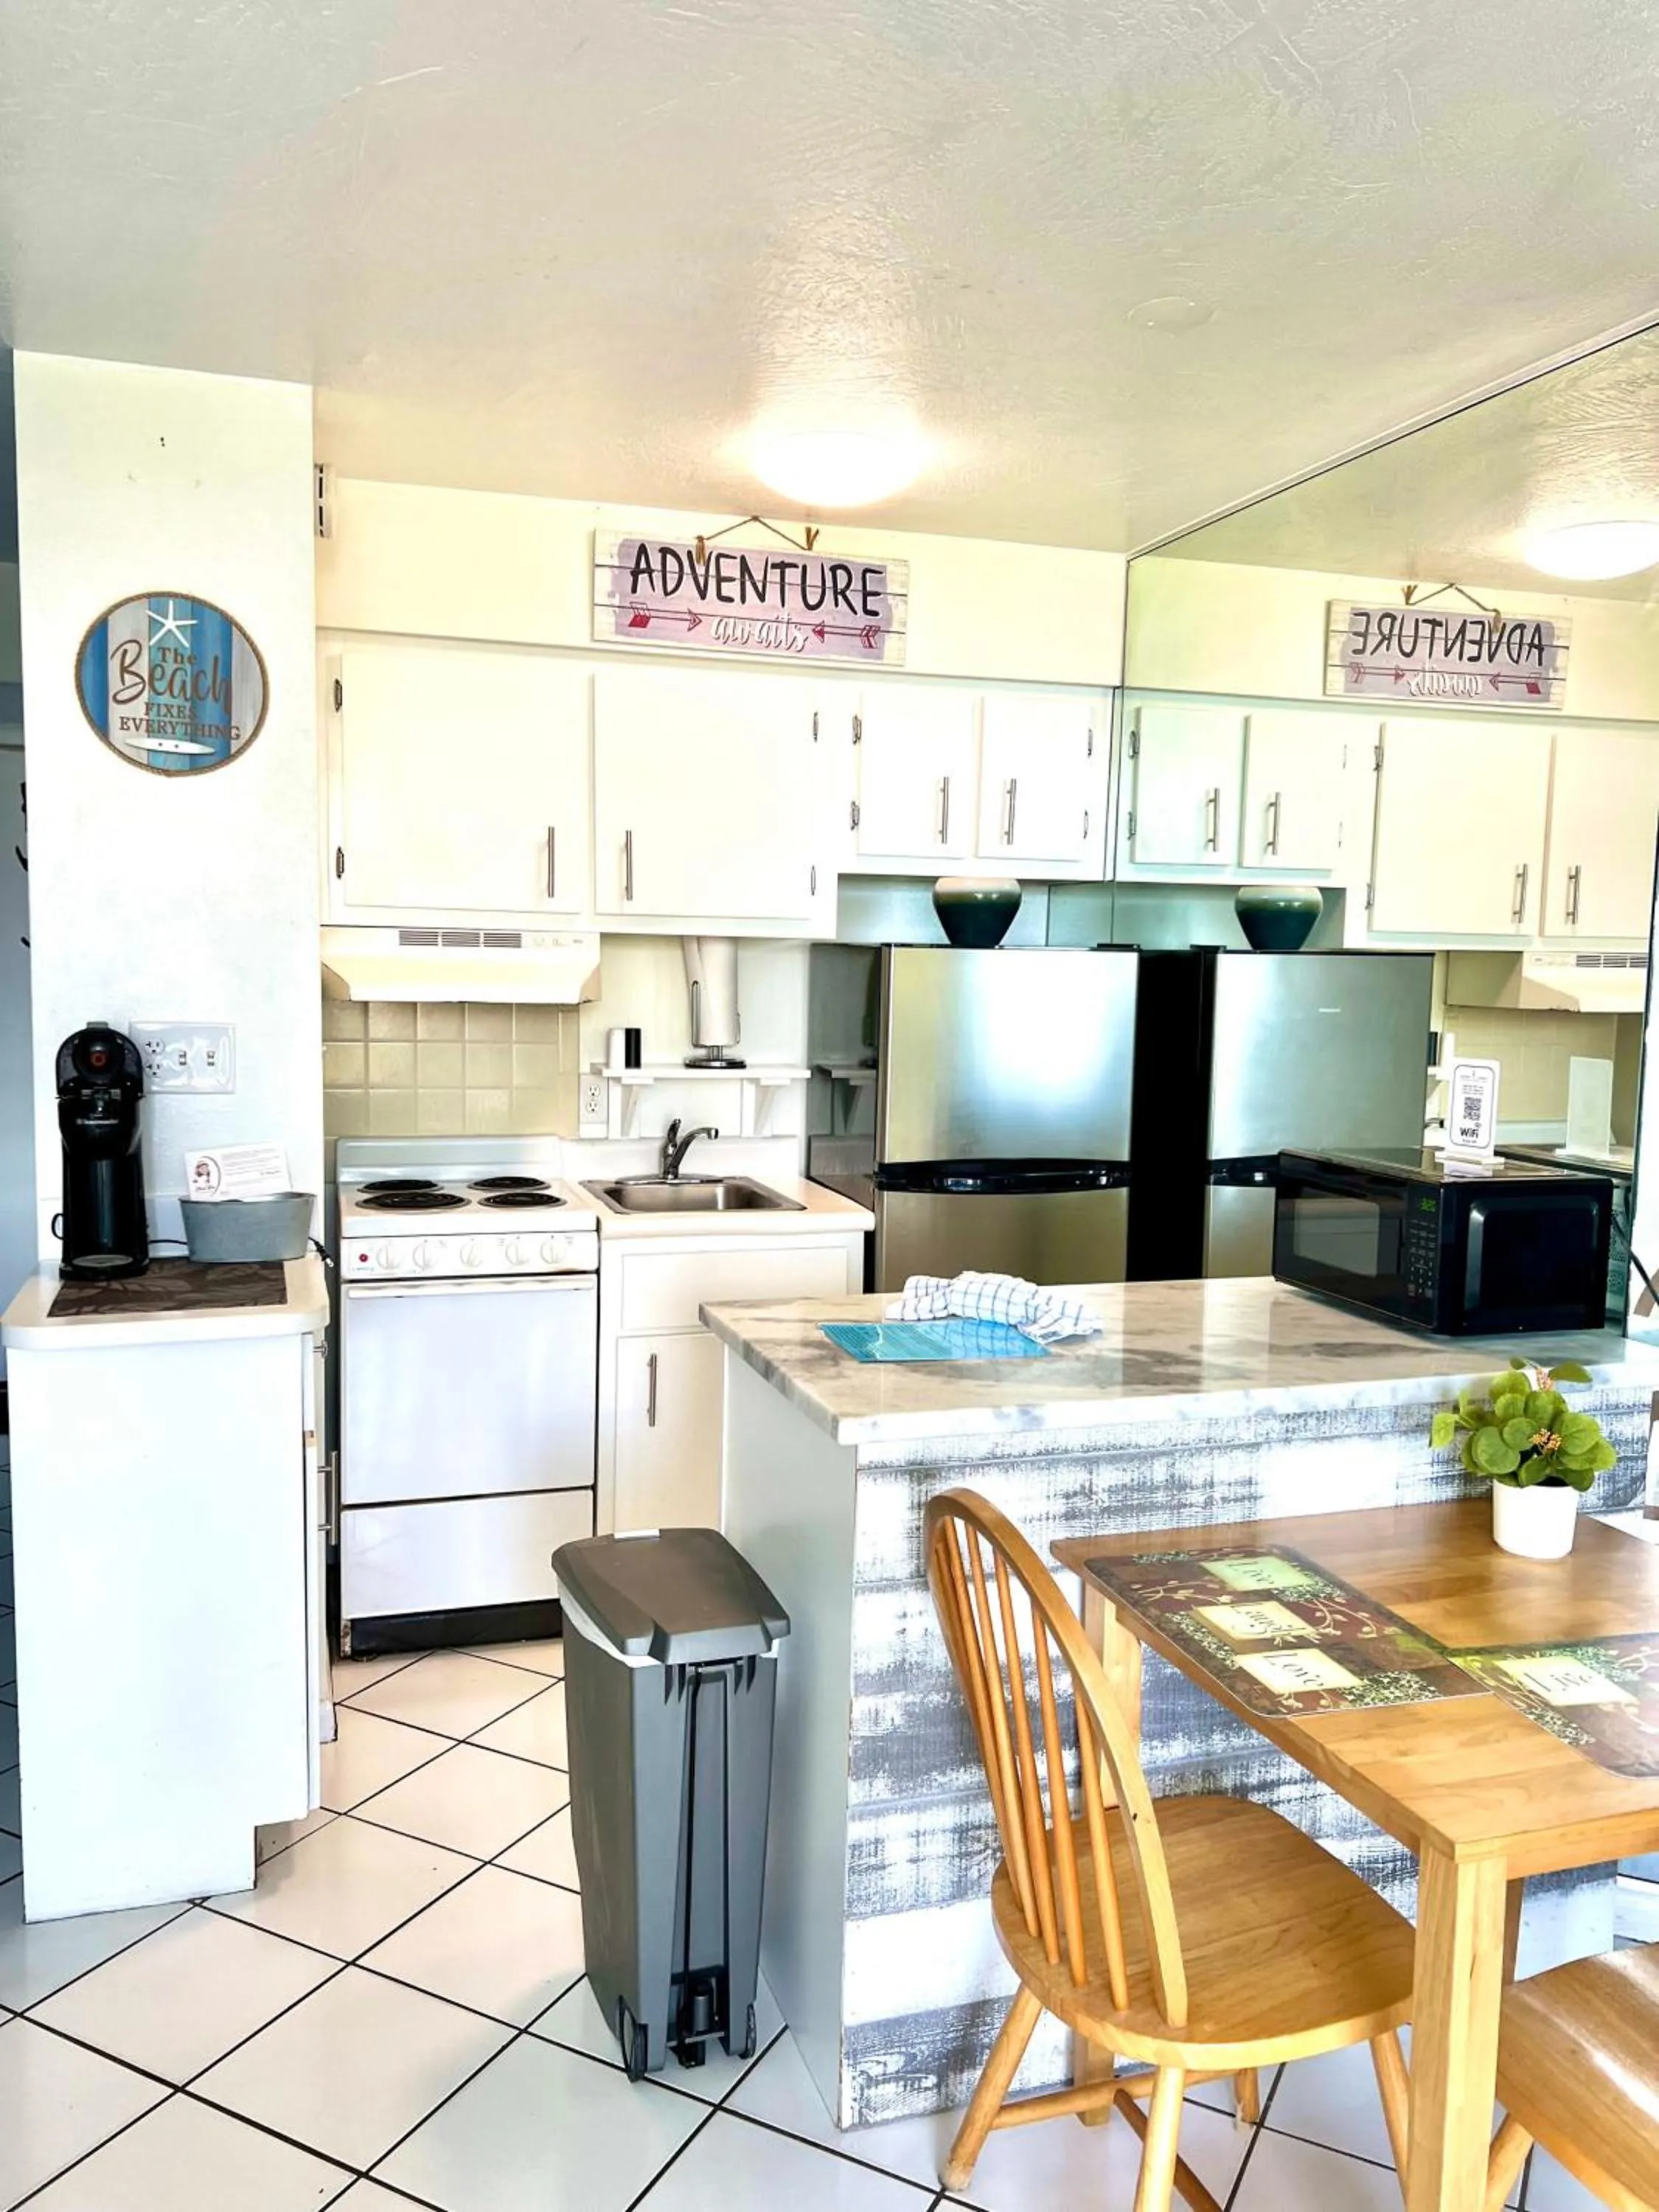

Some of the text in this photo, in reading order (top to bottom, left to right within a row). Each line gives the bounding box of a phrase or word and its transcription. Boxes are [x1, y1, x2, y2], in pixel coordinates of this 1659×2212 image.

[630, 543, 884, 616] ADVENTURE
[710, 612, 810, 653] awaits
[158, 647, 197, 665] The
[111, 639, 232, 715] Beach
[145, 701, 199, 721] FIXES
[119, 716, 241, 741] EVERYTHING
[1460, 1127, 1479, 1139] WiFi
[1263, 1653, 1324, 1687] Love
